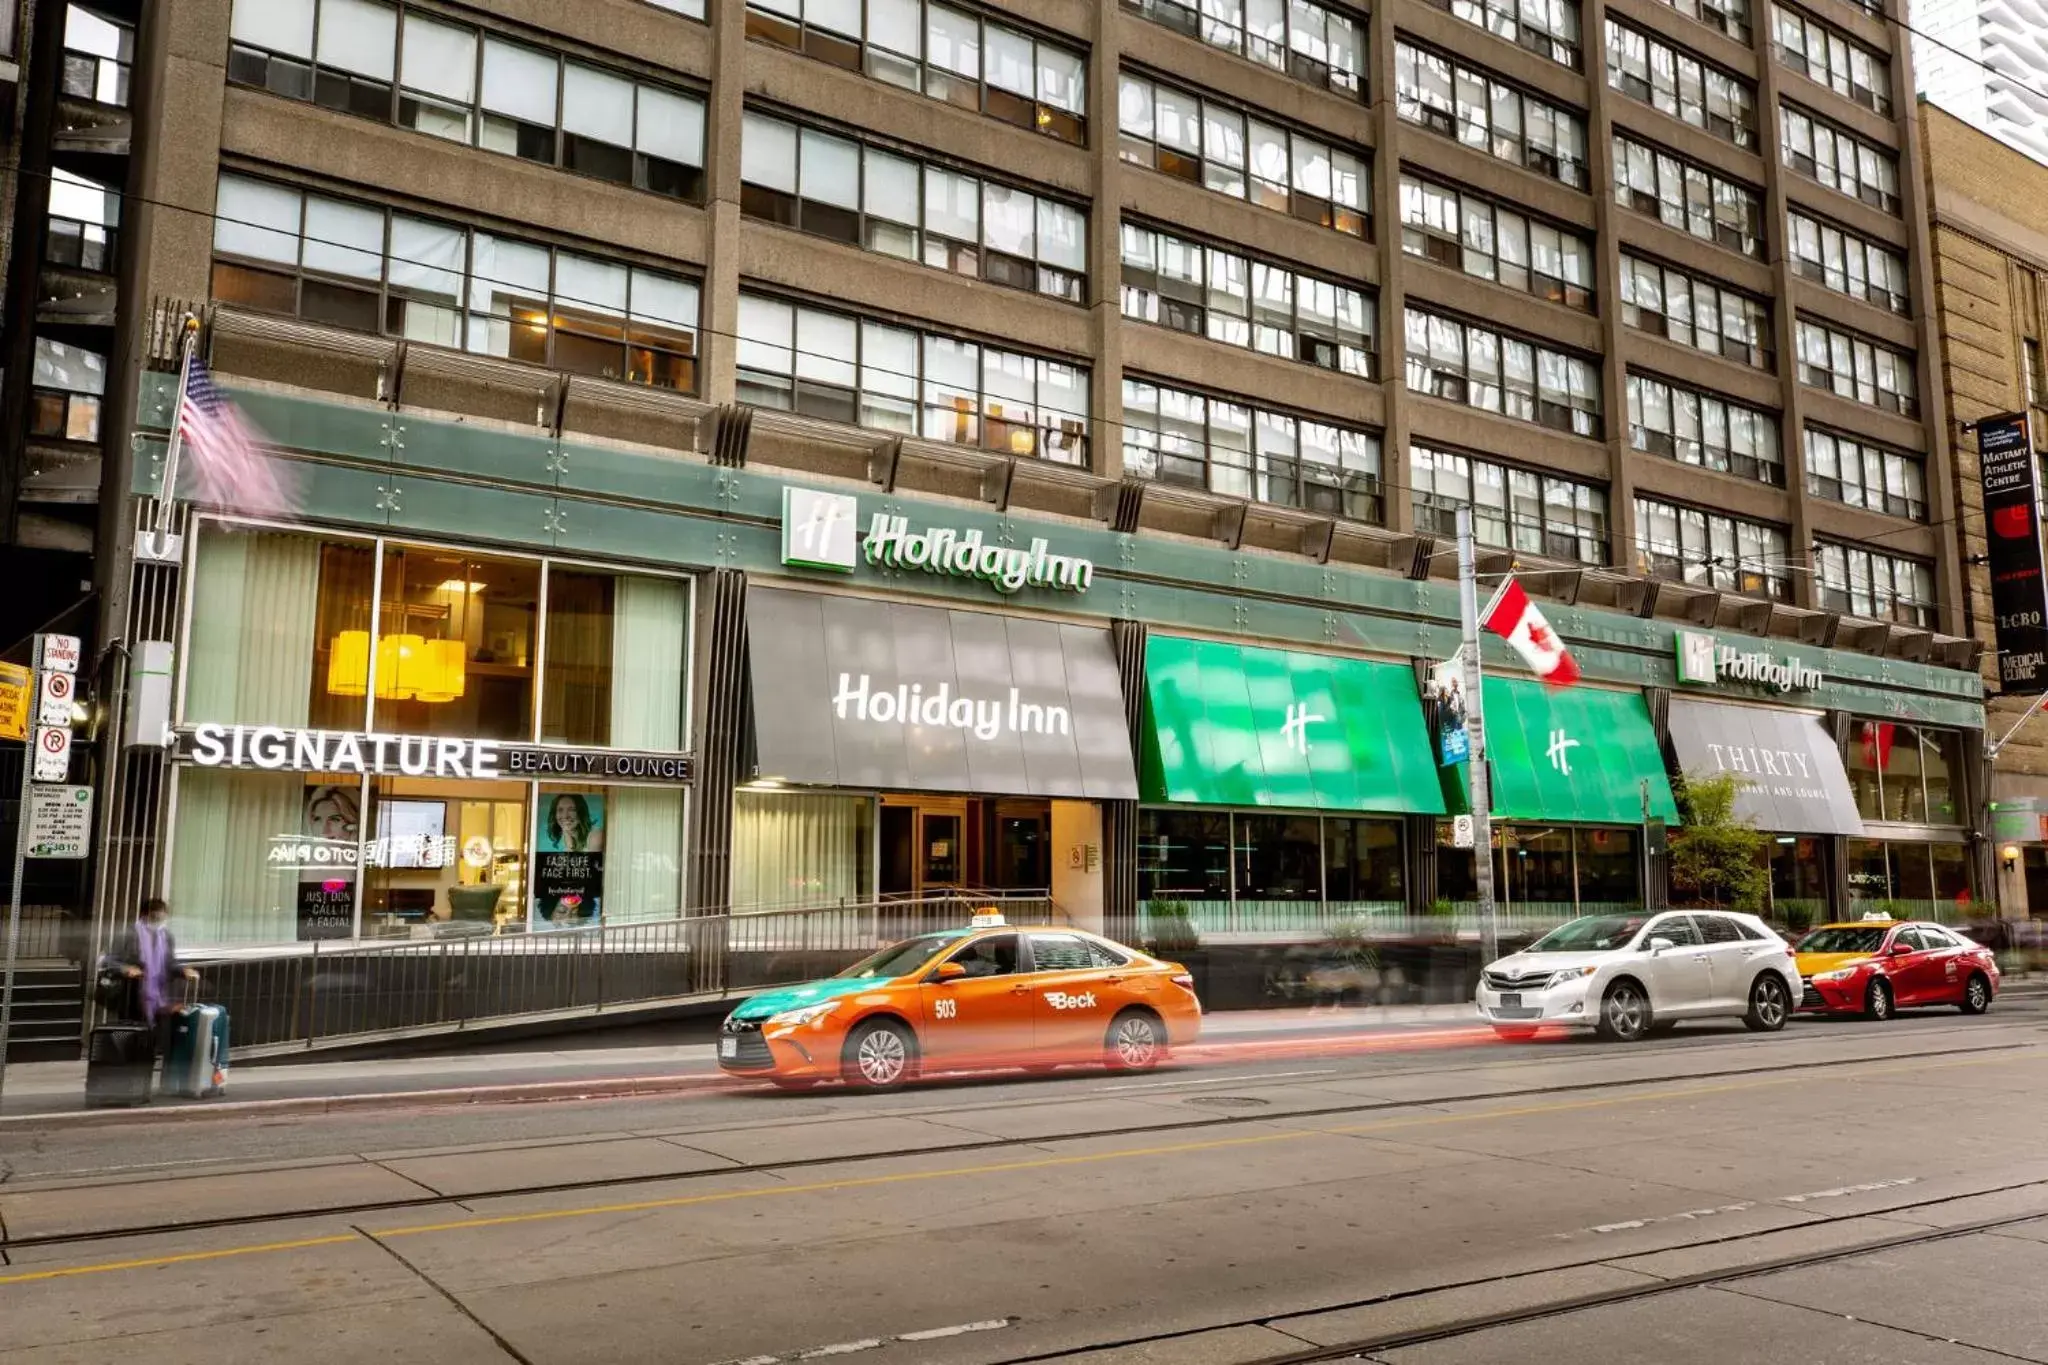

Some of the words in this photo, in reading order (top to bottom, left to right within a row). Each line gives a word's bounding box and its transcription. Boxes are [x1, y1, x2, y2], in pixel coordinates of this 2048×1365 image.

[1985, 460, 2027, 476] ATHLETIC
[1986, 473, 2020, 488] CENTRE
[863, 512, 1029, 593] Holiday
[1027, 537, 1093, 593] Inn
[1999, 611, 2041, 629] LCBO
[56, 638, 69, 650] NO
[47, 648, 78, 661] STANDING
[2002, 651, 2046, 669] MEDICAL
[1718, 645, 1793, 693] Holiday
[1786, 655, 1823, 690] Inn
[2003, 666, 2036, 682] CLINIC
[832, 672, 1001, 741] Holiday
[1008, 687, 1070, 736] Inn
[191, 722, 501, 778] SIGNATURE
[510, 751, 596, 774] BEAUTY
[604, 757, 689, 779] LOUNGE
[1707, 743, 1809, 779] THIRTY
[1774, 786, 1793, 797] AND
[1796, 787, 1832, 800] LOUNGE
[541, 867, 564, 879] FACE
[305, 890, 328, 903] JUST
[312, 904, 338, 916] CALL
[341, 904, 351, 916] IT
[306, 917, 314, 928] A
[317, 916, 350, 928] FACIAL
[935, 998, 956, 1019] 503
[1055, 991, 1097, 1010] Beck
